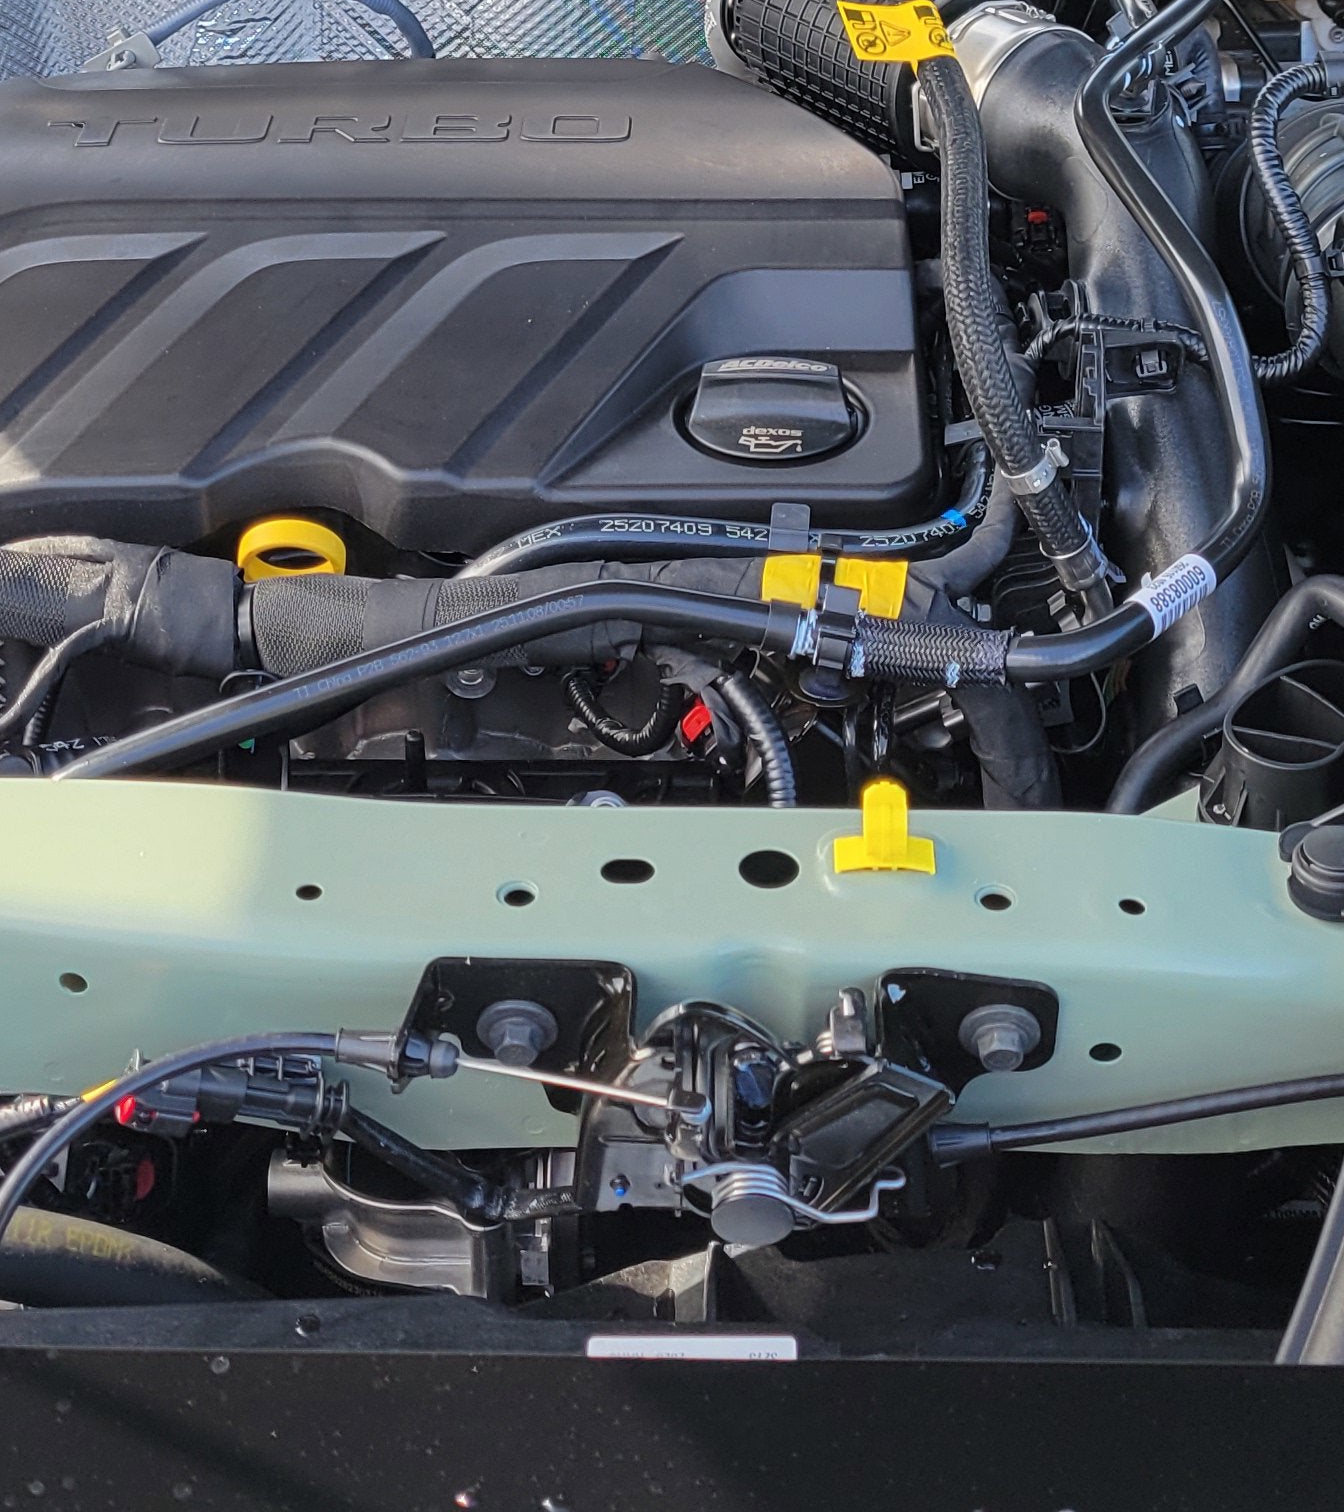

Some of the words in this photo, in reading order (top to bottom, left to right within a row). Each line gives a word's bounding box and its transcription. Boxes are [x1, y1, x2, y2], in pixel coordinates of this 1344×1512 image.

[50, 114, 632, 148] TURBO
[717, 359, 828, 373] ACDelco
[742, 426, 804, 437] dexos
[599, 519, 712, 536] 25207409
[726, 525, 769, 541] 542
[1150, 565, 1206, 614] 60008388
